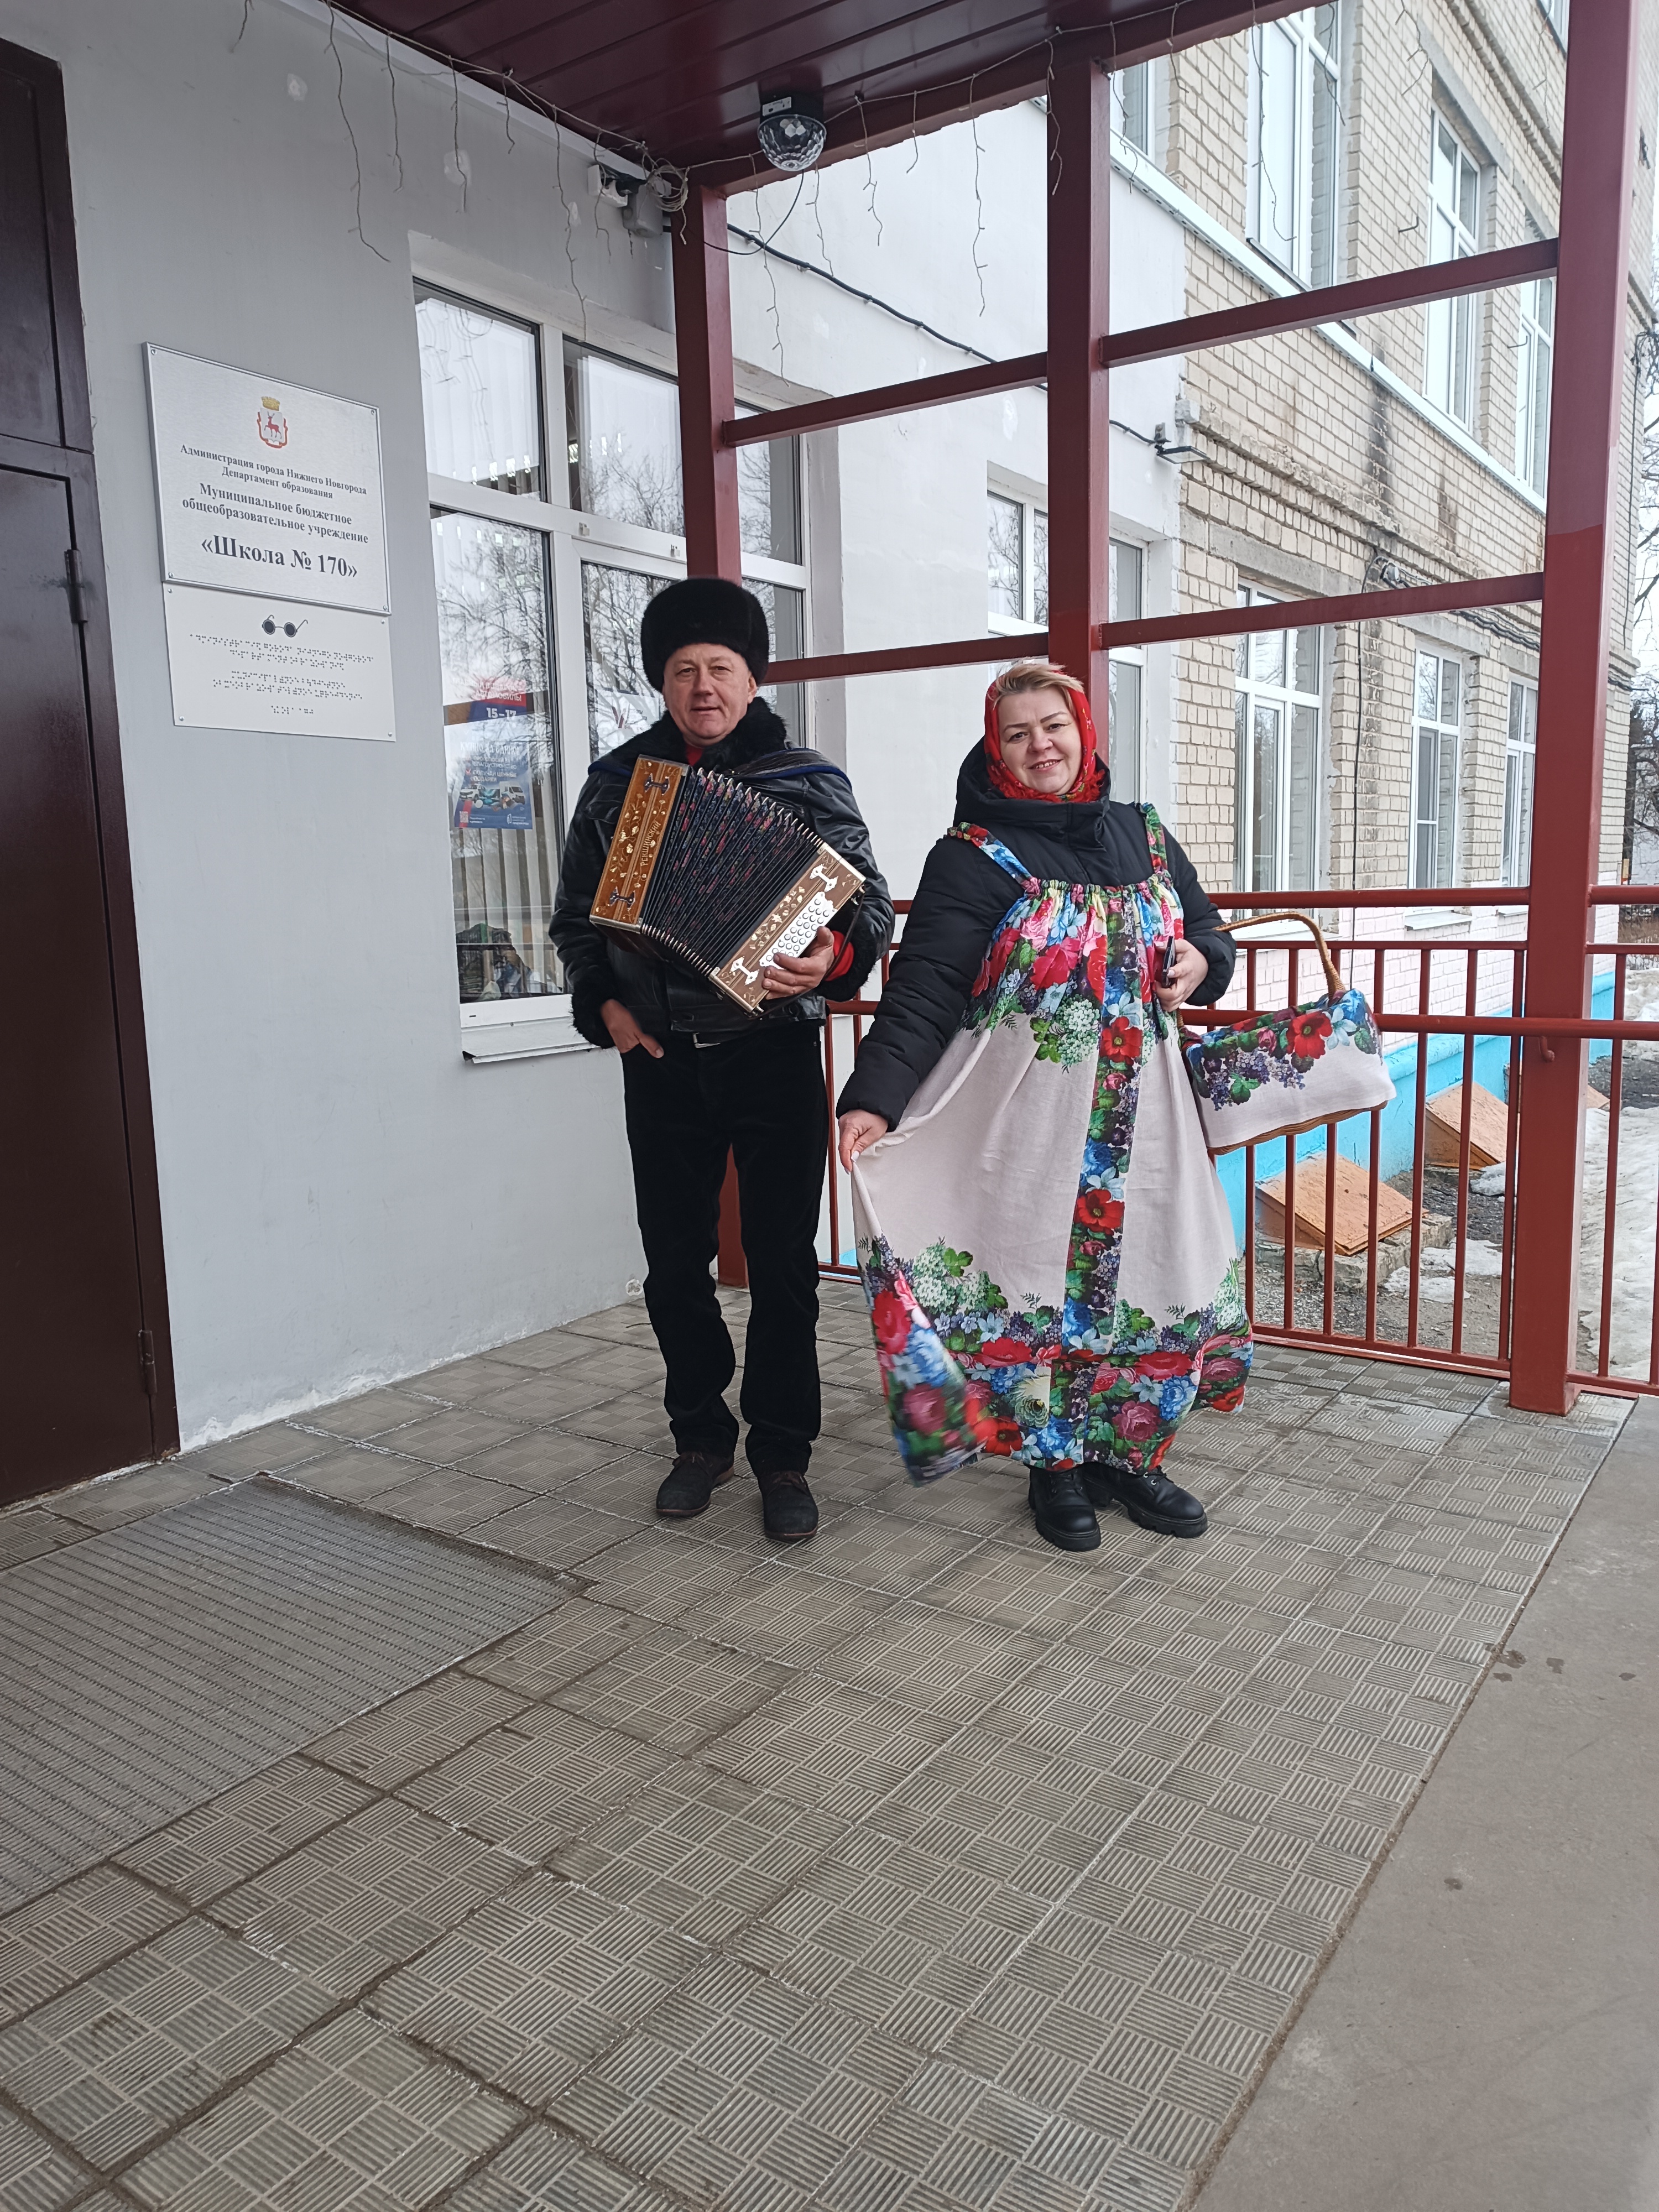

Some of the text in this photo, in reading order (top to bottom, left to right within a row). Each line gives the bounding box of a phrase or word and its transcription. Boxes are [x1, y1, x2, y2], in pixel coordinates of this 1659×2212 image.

[180, 445, 367, 495] Администрация города Нижнего Новгорода
[222, 466, 333, 499] Департамент образования
[182, 498, 369, 544] общеобразовательное учреждение
[199, 482, 352, 525] Муниципальное бюджетное
[201, 534, 358, 577] «Школа № 170»
